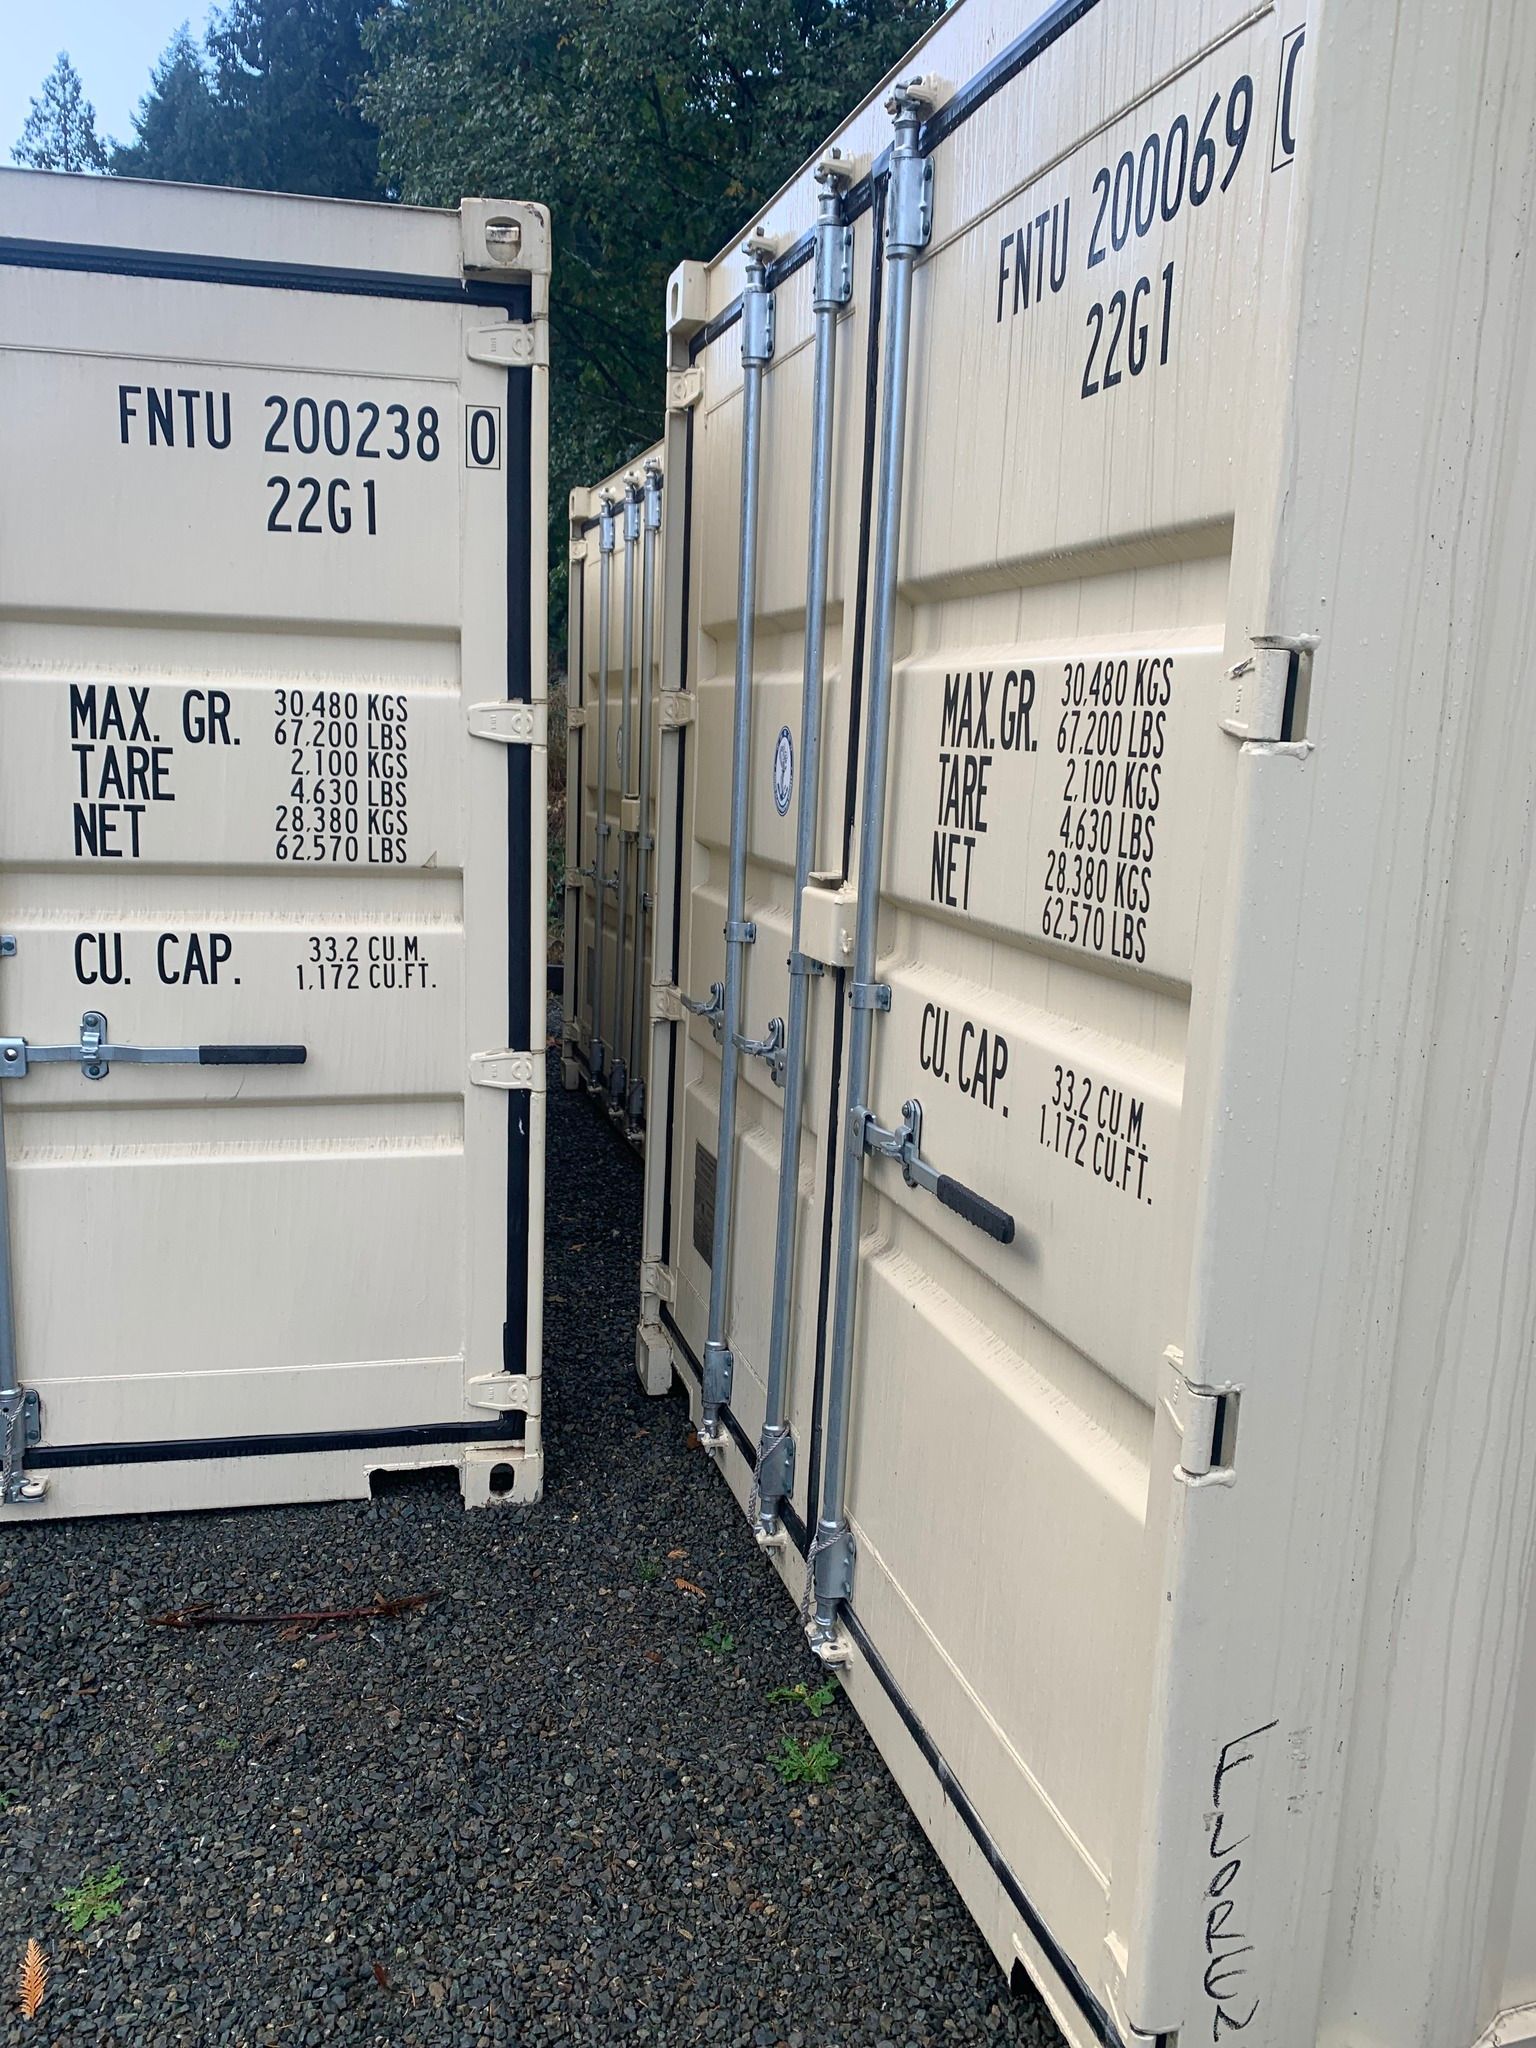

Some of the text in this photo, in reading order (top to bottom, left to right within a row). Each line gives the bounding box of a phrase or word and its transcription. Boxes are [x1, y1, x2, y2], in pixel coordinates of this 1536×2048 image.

[996, 196, 1071, 324] FNTU
[1087, 74, 1254, 270] 200069
[1080, 260, 1175, 400] 22G1
[118, 384, 496, 466] FNTU 200238 0
[266, 475, 378, 536] 22G1
[367, 693, 408, 723] KGS
[1000, 669, 1038, 752] GR.
[1061, 657, 1174, 707] 30,480 KGS
[69, 683, 241, 745] MAX. GR.
[367, 722, 407, 751] LBS
[1056, 710, 1167, 759] 67,200 LBS
[71, 743, 176, 802] TARE
[367, 751, 408, 780] KGS
[367, 779, 408, 808] LBS
[937, 753, 993, 833] TARE
[1063, 758, 1162, 812] 2,100 KGS
[73, 802, 146, 858] NET
[368, 808, 408, 836] KGS
[368, 836, 408, 864] LBS
[1059, 805, 1156, 863] 4,630 LBS
[930, 830, 976, 911] NET
[1044, 849, 1152, 914] 28,380 KGS
[74, 932, 241, 985] CU. CAP.
[308, 936, 359, 963] 33.2
[1042, 895, 1147, 964] 62,570 LBS
[958, 1021, 1009, 1119] CAP.
[1051, 1064, 1092, 1122] 33.2
